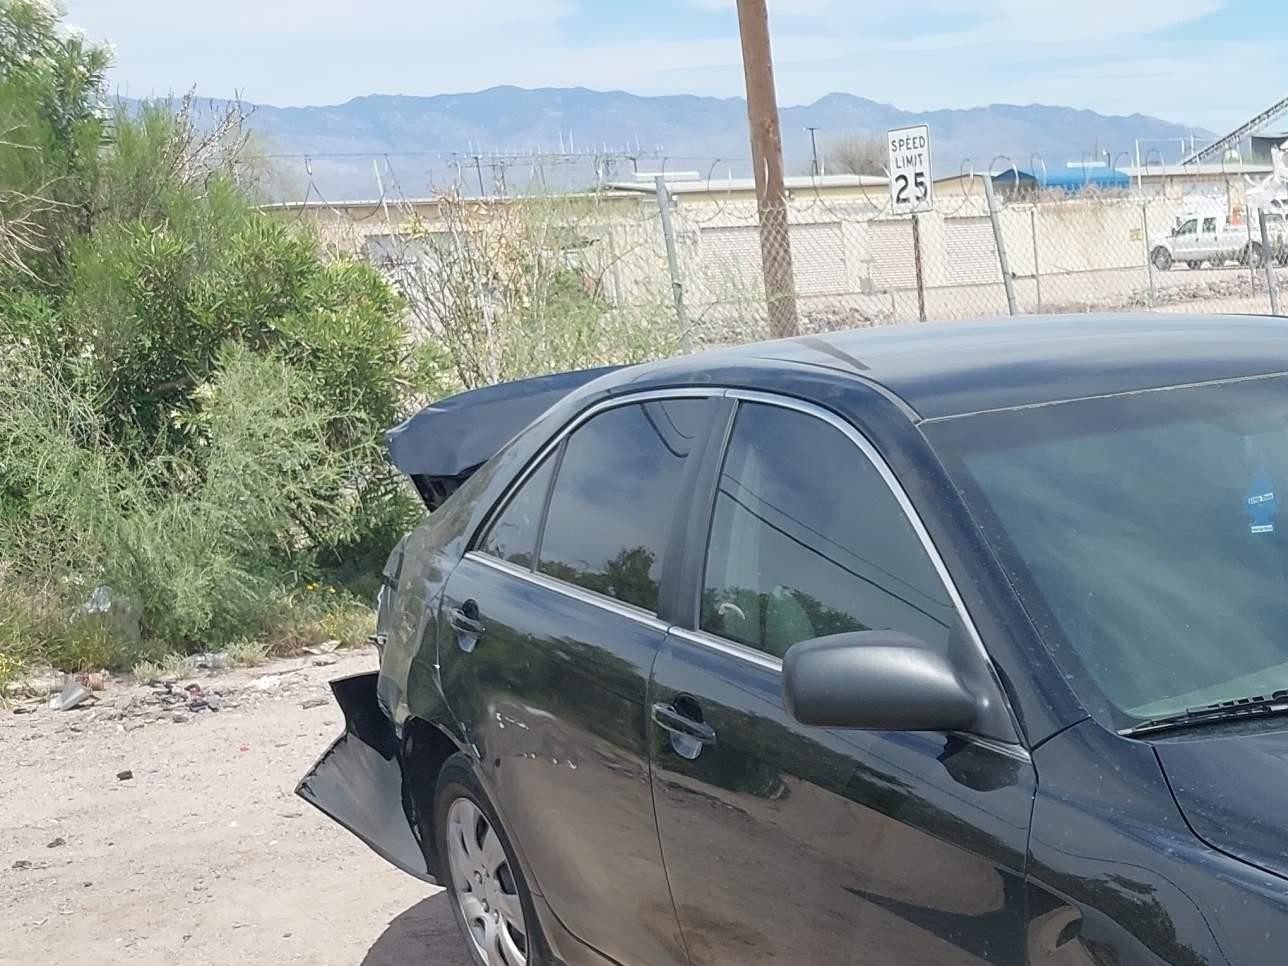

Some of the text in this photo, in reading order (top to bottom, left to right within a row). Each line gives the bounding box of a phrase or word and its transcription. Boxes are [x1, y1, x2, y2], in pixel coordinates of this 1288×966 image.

[891, 135, 926, 153] SPEED
[895, 153, 923, 169] LIMIT
[895, 171, 928, 204] 25
